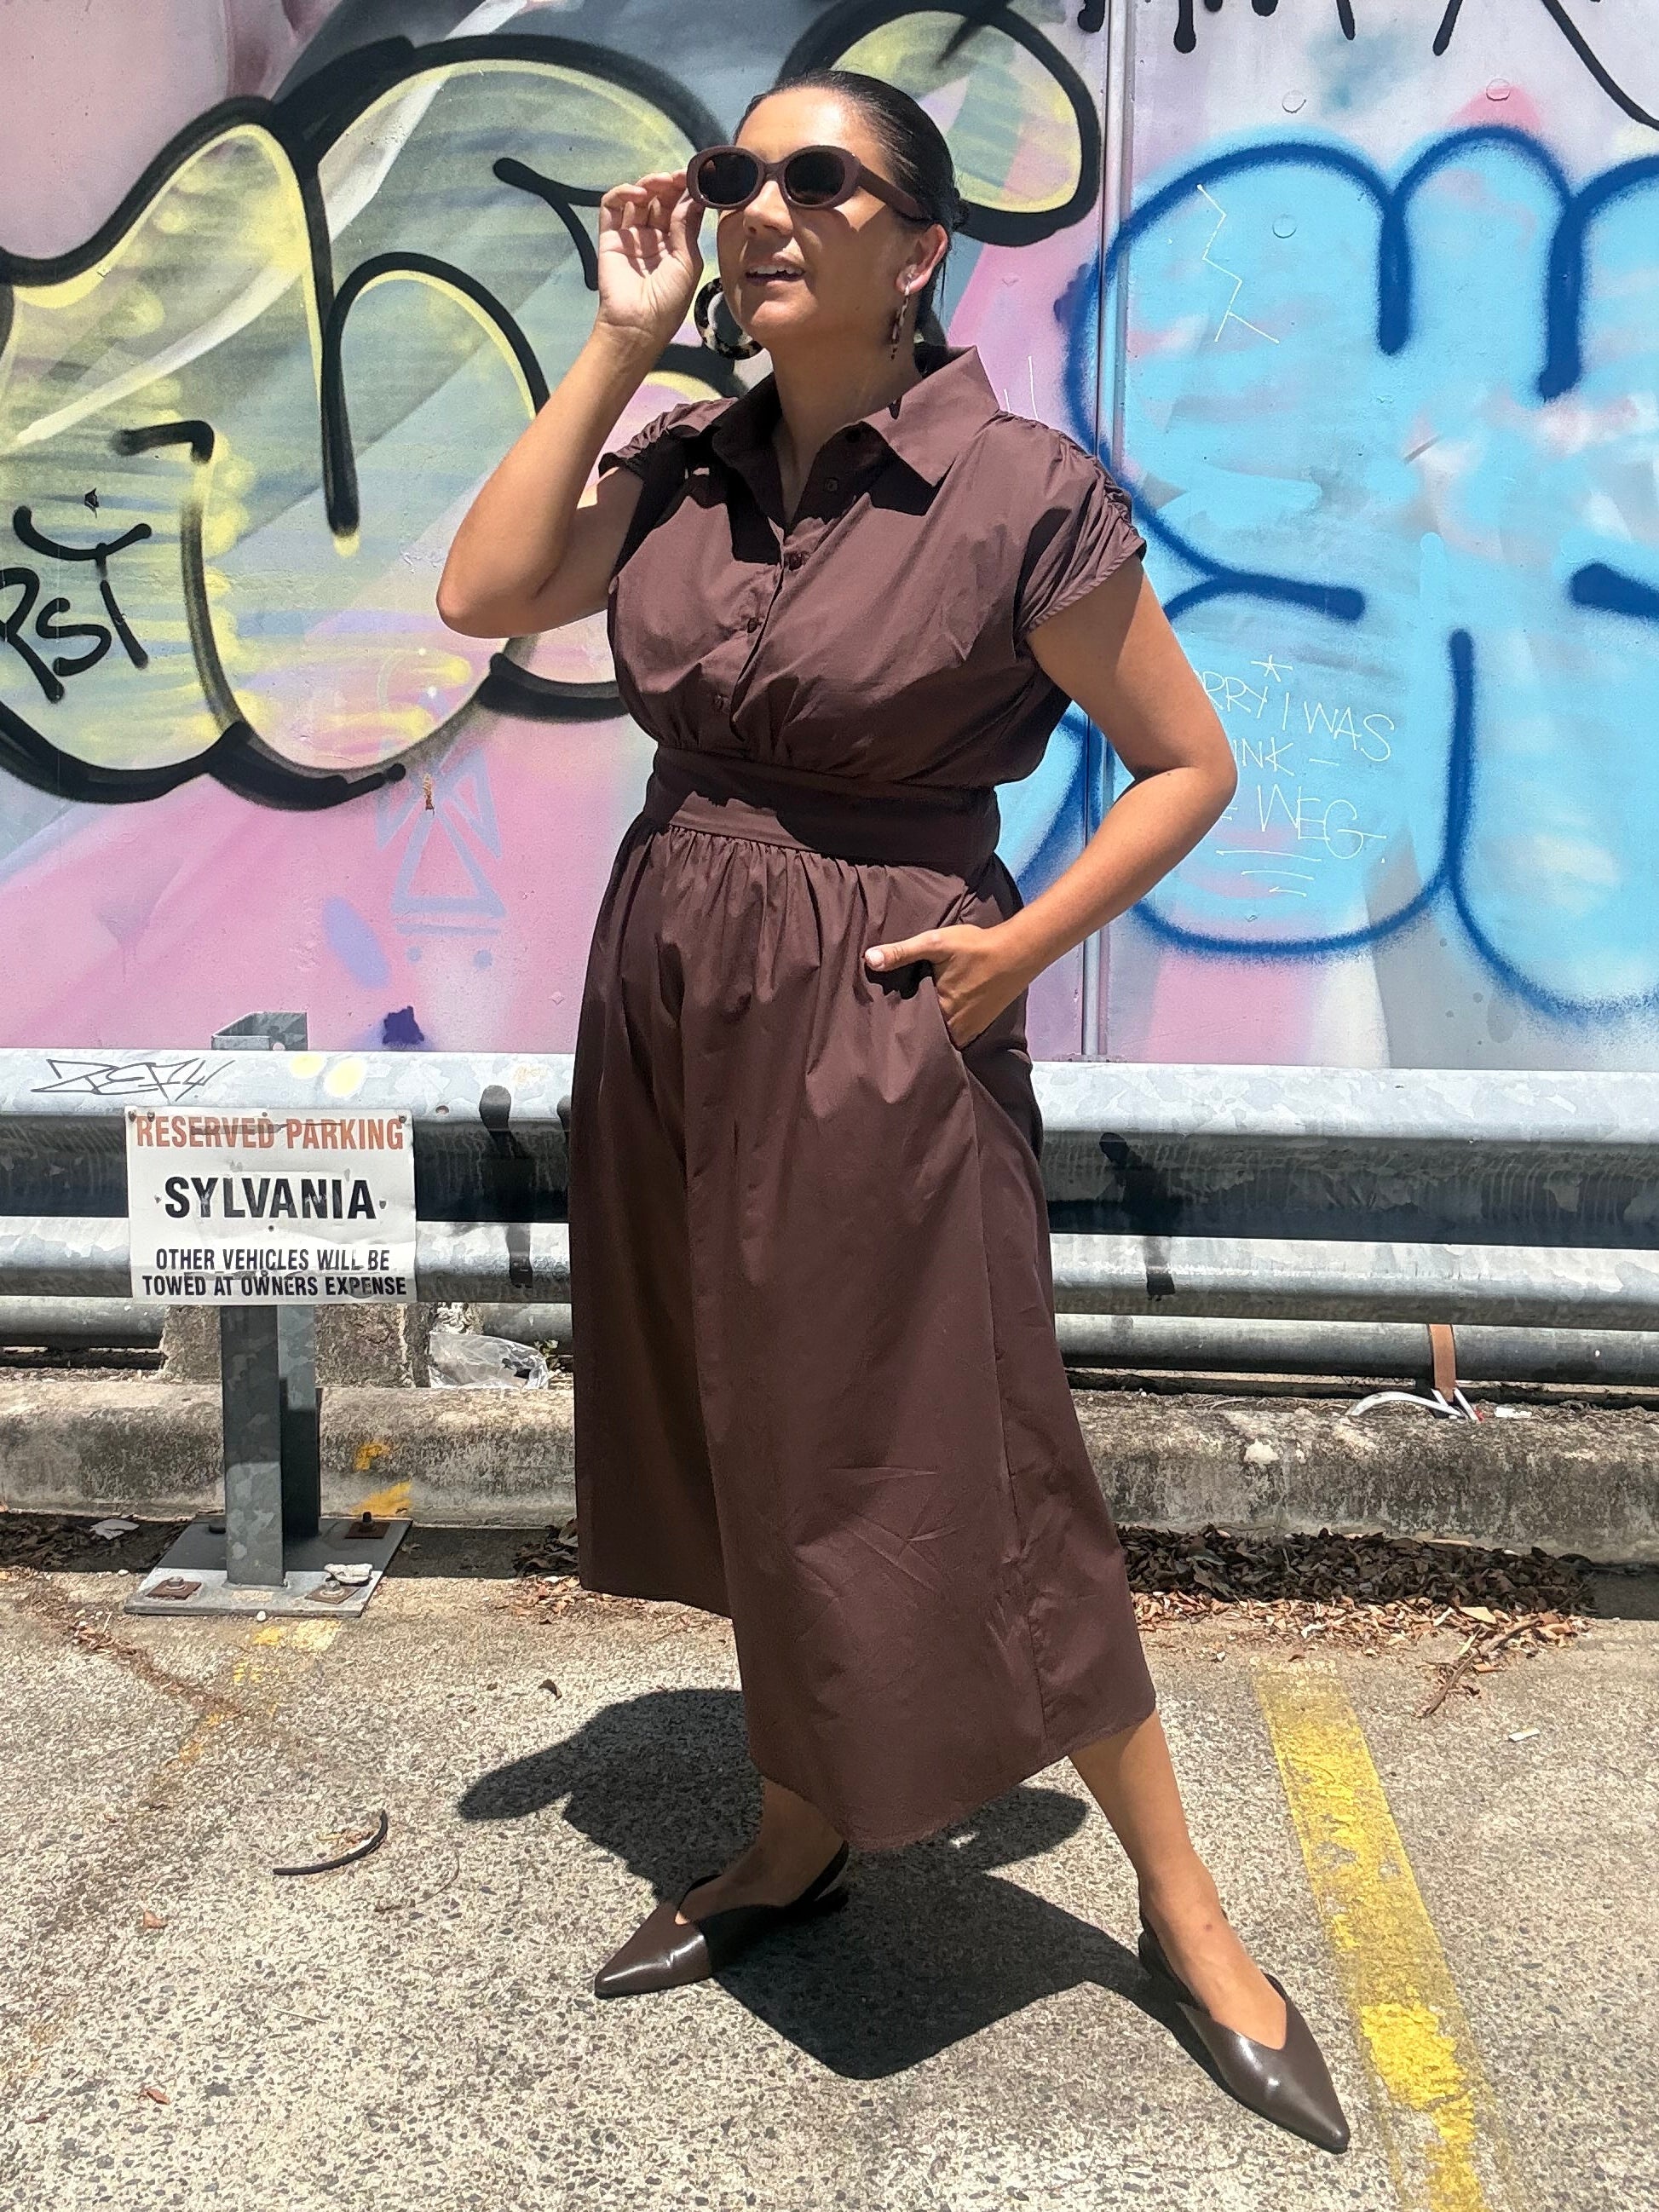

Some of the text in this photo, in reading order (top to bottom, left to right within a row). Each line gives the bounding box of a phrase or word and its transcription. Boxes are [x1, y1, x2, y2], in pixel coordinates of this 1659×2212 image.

[1193, 670, 1395, 762] RRY I WAS
[136, 1115, 404, 1150] RESERVED PARKING
[164, 1176, 377, 1220] SYLVANIA
[156, 1248, 390, 1271] OTHER VEHICLES WILL BE
[142, 1275, 407, 1296] TOWED AT OWNERS EXPENSE
